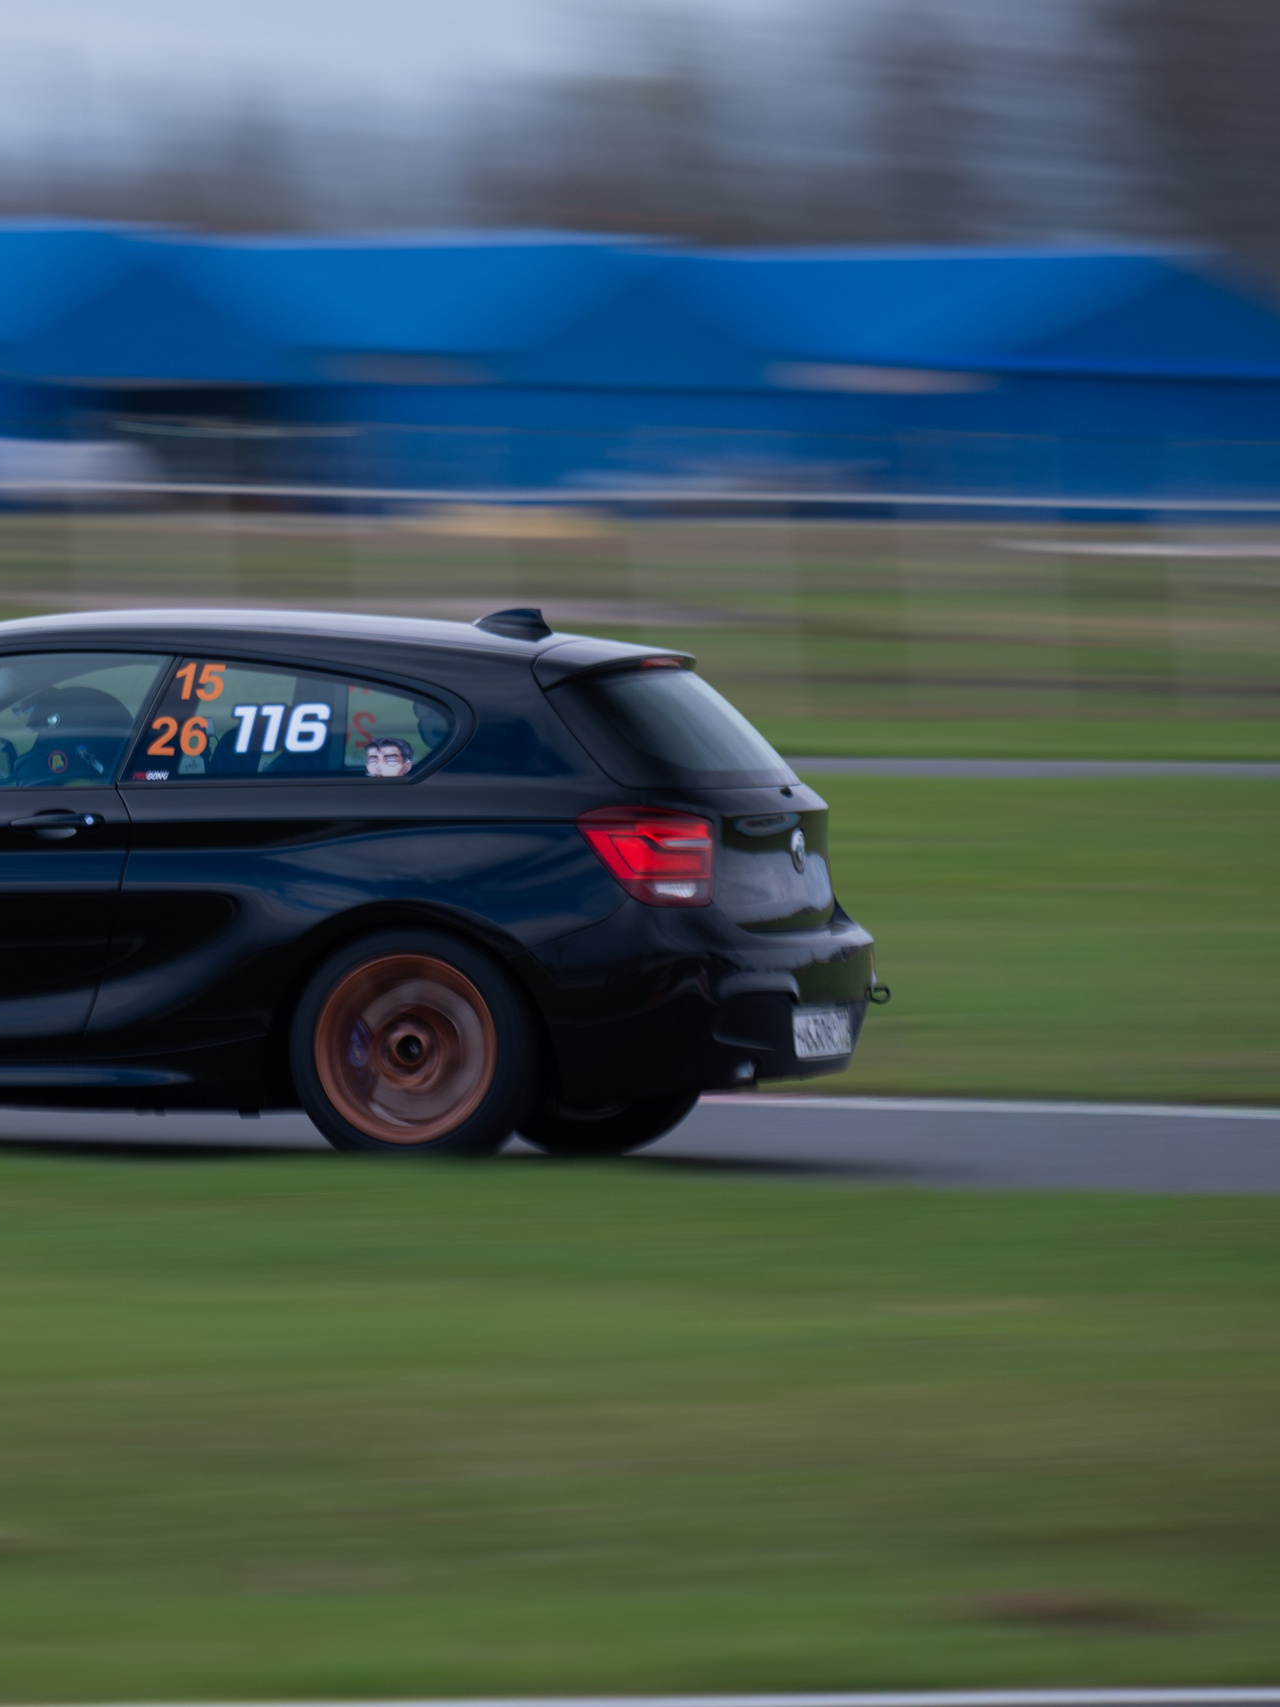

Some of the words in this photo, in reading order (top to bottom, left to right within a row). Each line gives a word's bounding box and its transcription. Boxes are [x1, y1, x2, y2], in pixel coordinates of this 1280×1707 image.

[176, 663, 226, 701] 15
[147, 716, 208, 756] 26
[233, 703, 331, 753] 116
